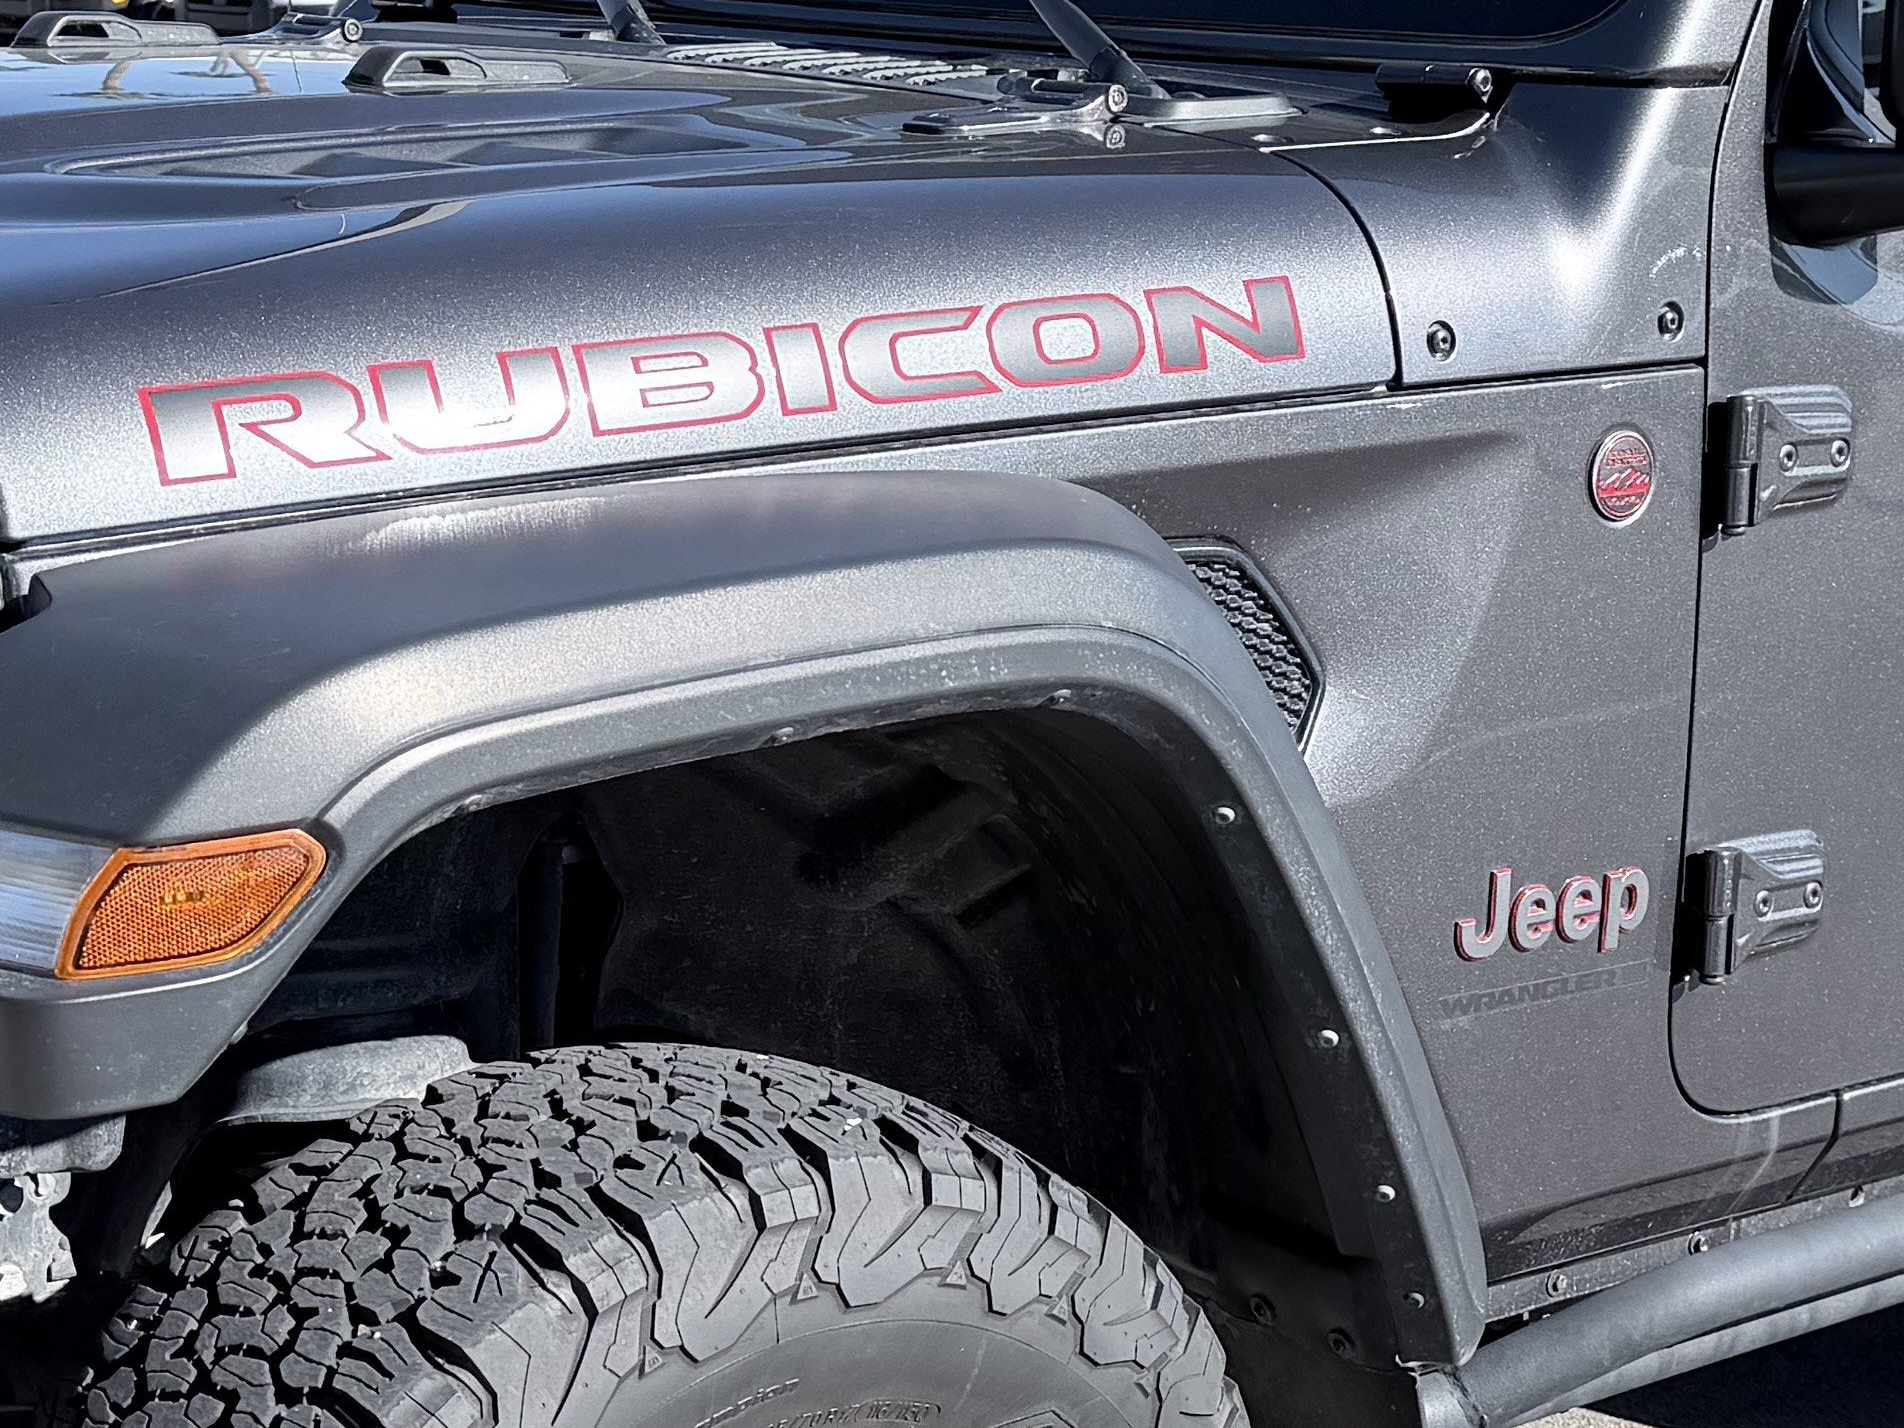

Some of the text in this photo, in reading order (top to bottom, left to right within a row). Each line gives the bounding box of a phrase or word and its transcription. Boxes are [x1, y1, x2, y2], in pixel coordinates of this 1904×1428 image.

[135, 275, 1306, 487] RUBICON
[1453, 866, 1650, 963] Jeep
[1440, 969, 1621, 1020] WRANGLER
